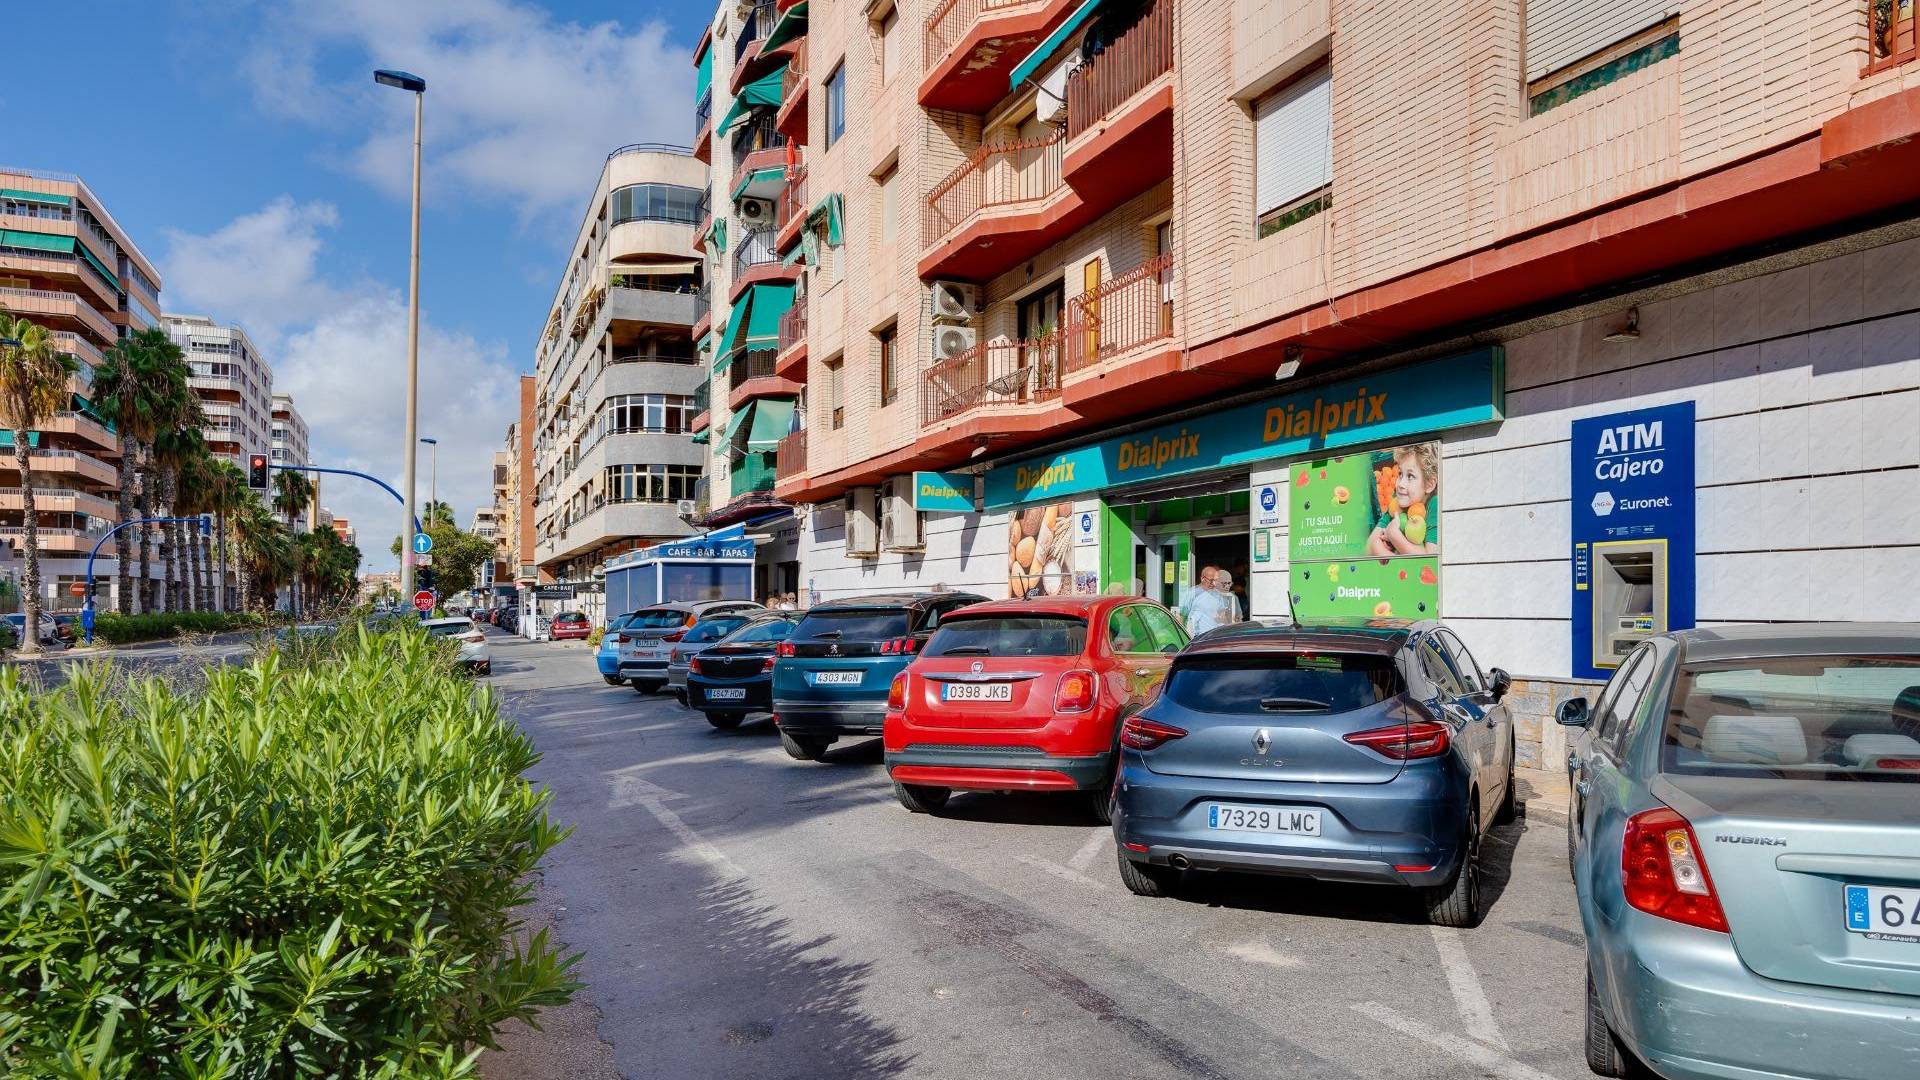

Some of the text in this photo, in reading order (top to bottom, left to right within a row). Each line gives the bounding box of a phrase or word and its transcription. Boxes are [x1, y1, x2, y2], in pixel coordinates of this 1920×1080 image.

[1262, 387, 1388, 443] Dialprix
[1596, 420, 1663, 455] ATM
[1117, 428, 1200, 472] Dialprix
[1015, 455, 1076, 493] Dialprix
[1595, 457, 1664, 482] Cajero
[920, 484, 972, 499] Dialprix
[1305, 517, 1316, 527] TU
[1316, 515, 1343, 526] SALUD
[1298, 536, 1323, 546] JUSTO
[667, 547, 691, 557] CAFE
[697, 548, 715, 557] BAR
[720, 548, 748, 557] TAPAS
[1337, 585, 1381, 601] Dialprix
[817, 673, 859, 683] 4303 MGN
[949, 685, 1009, 699] 0398 JKB
[1239, 758, 1285, 767] CLIO
[1221, 808, 1315, 832] 7329 LMC
[1714, 834, 1788, 847] NUBIRA
[1854, 911, 1865, 922] E
